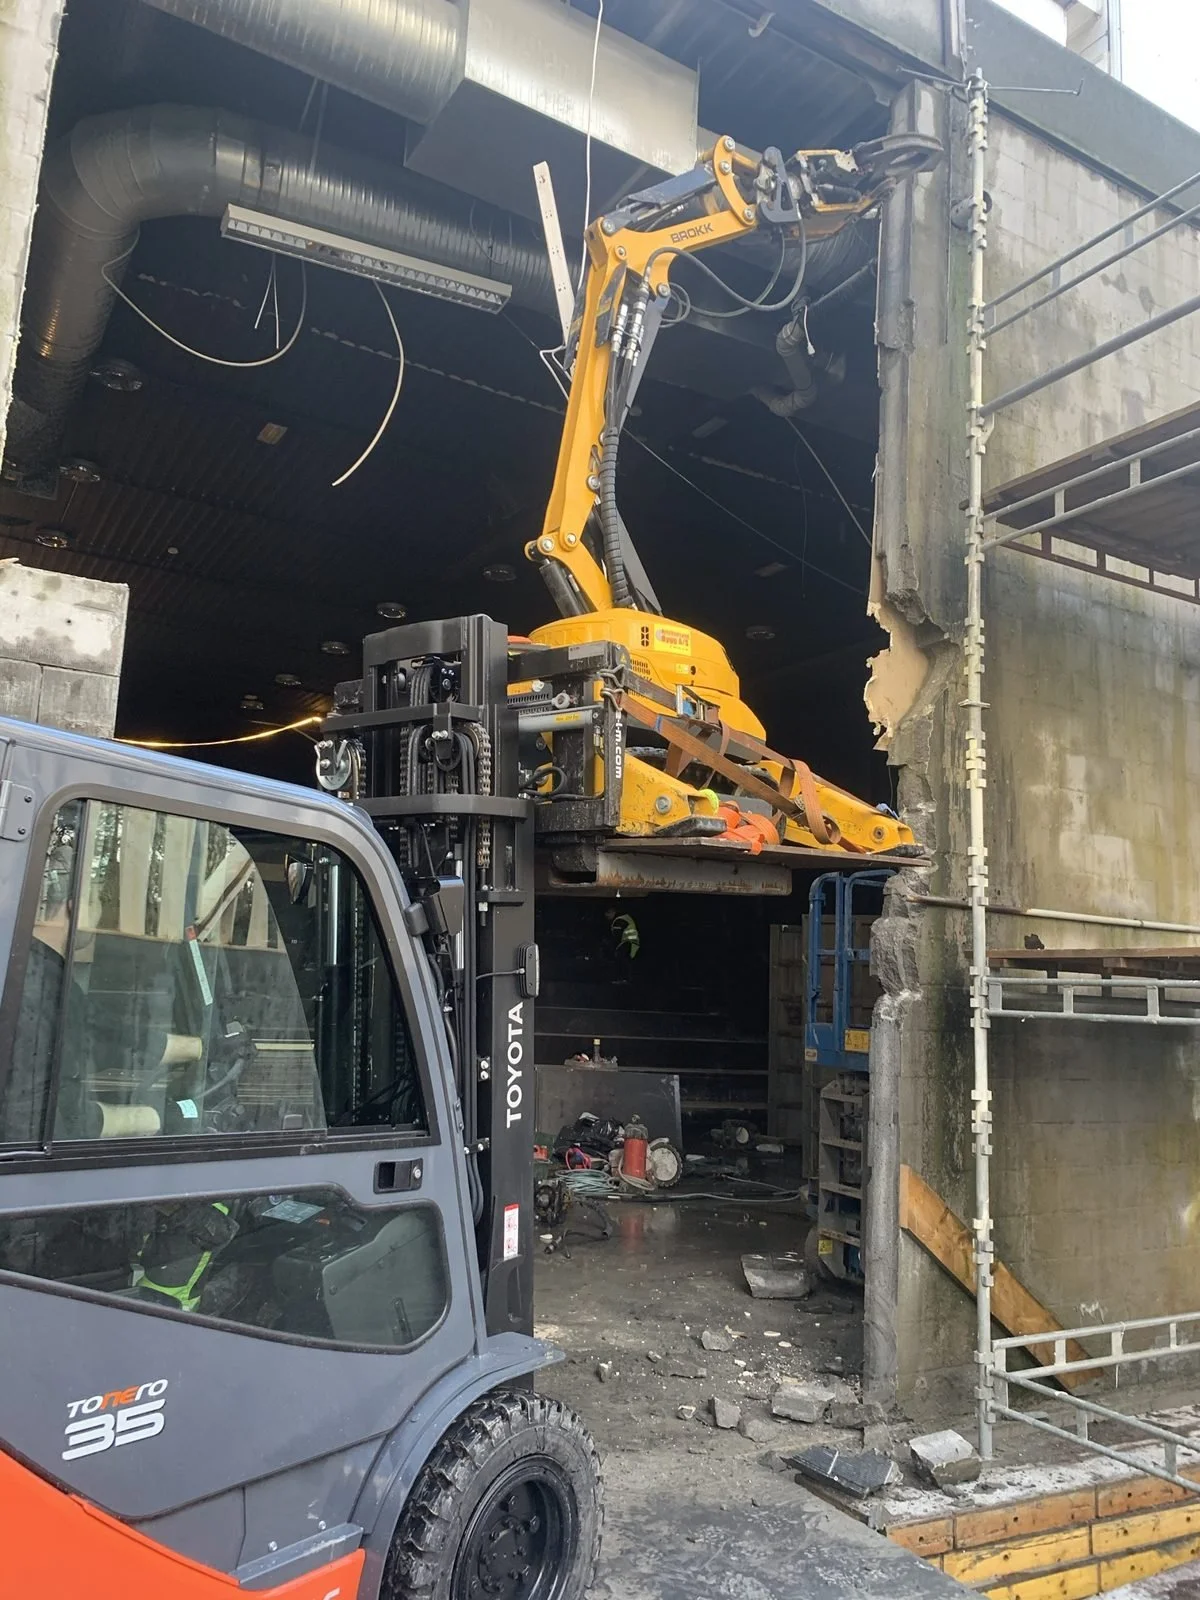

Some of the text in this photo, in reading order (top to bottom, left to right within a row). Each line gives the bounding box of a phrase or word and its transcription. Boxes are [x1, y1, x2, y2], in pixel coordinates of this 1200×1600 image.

[670, 223, 714, 244] BROKK
[506, 1001, 523, 1129] TOYOTA
[62, 1398, 166, 1461] 35
